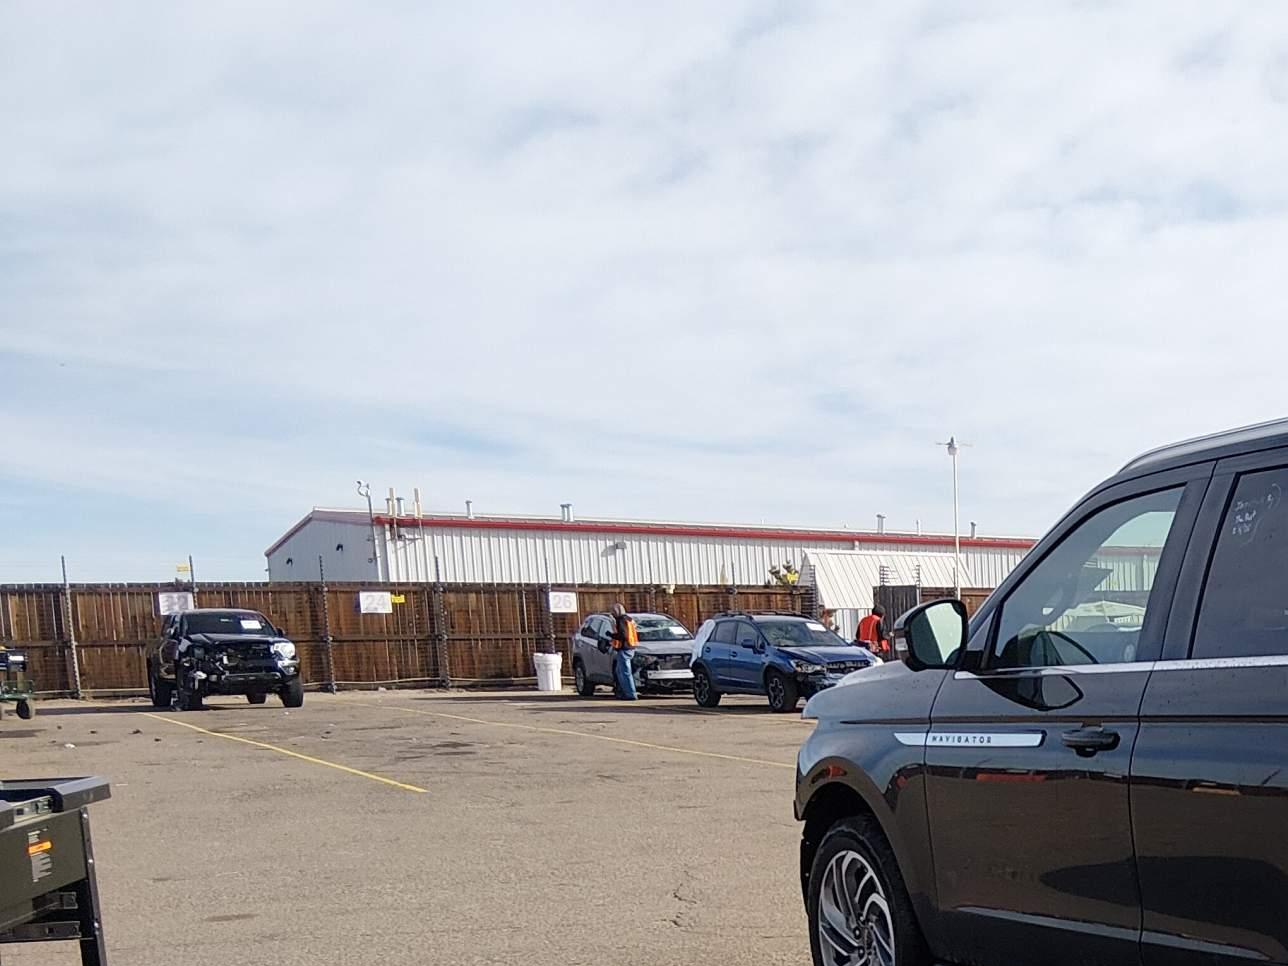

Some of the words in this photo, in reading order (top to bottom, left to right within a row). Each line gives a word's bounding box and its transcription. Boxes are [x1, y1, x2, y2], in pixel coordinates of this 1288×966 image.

[365, 594, 385, 611] 24
[553, 594, 573, 609] 26
[931, 735, 992, 744] NAVIGATOR
